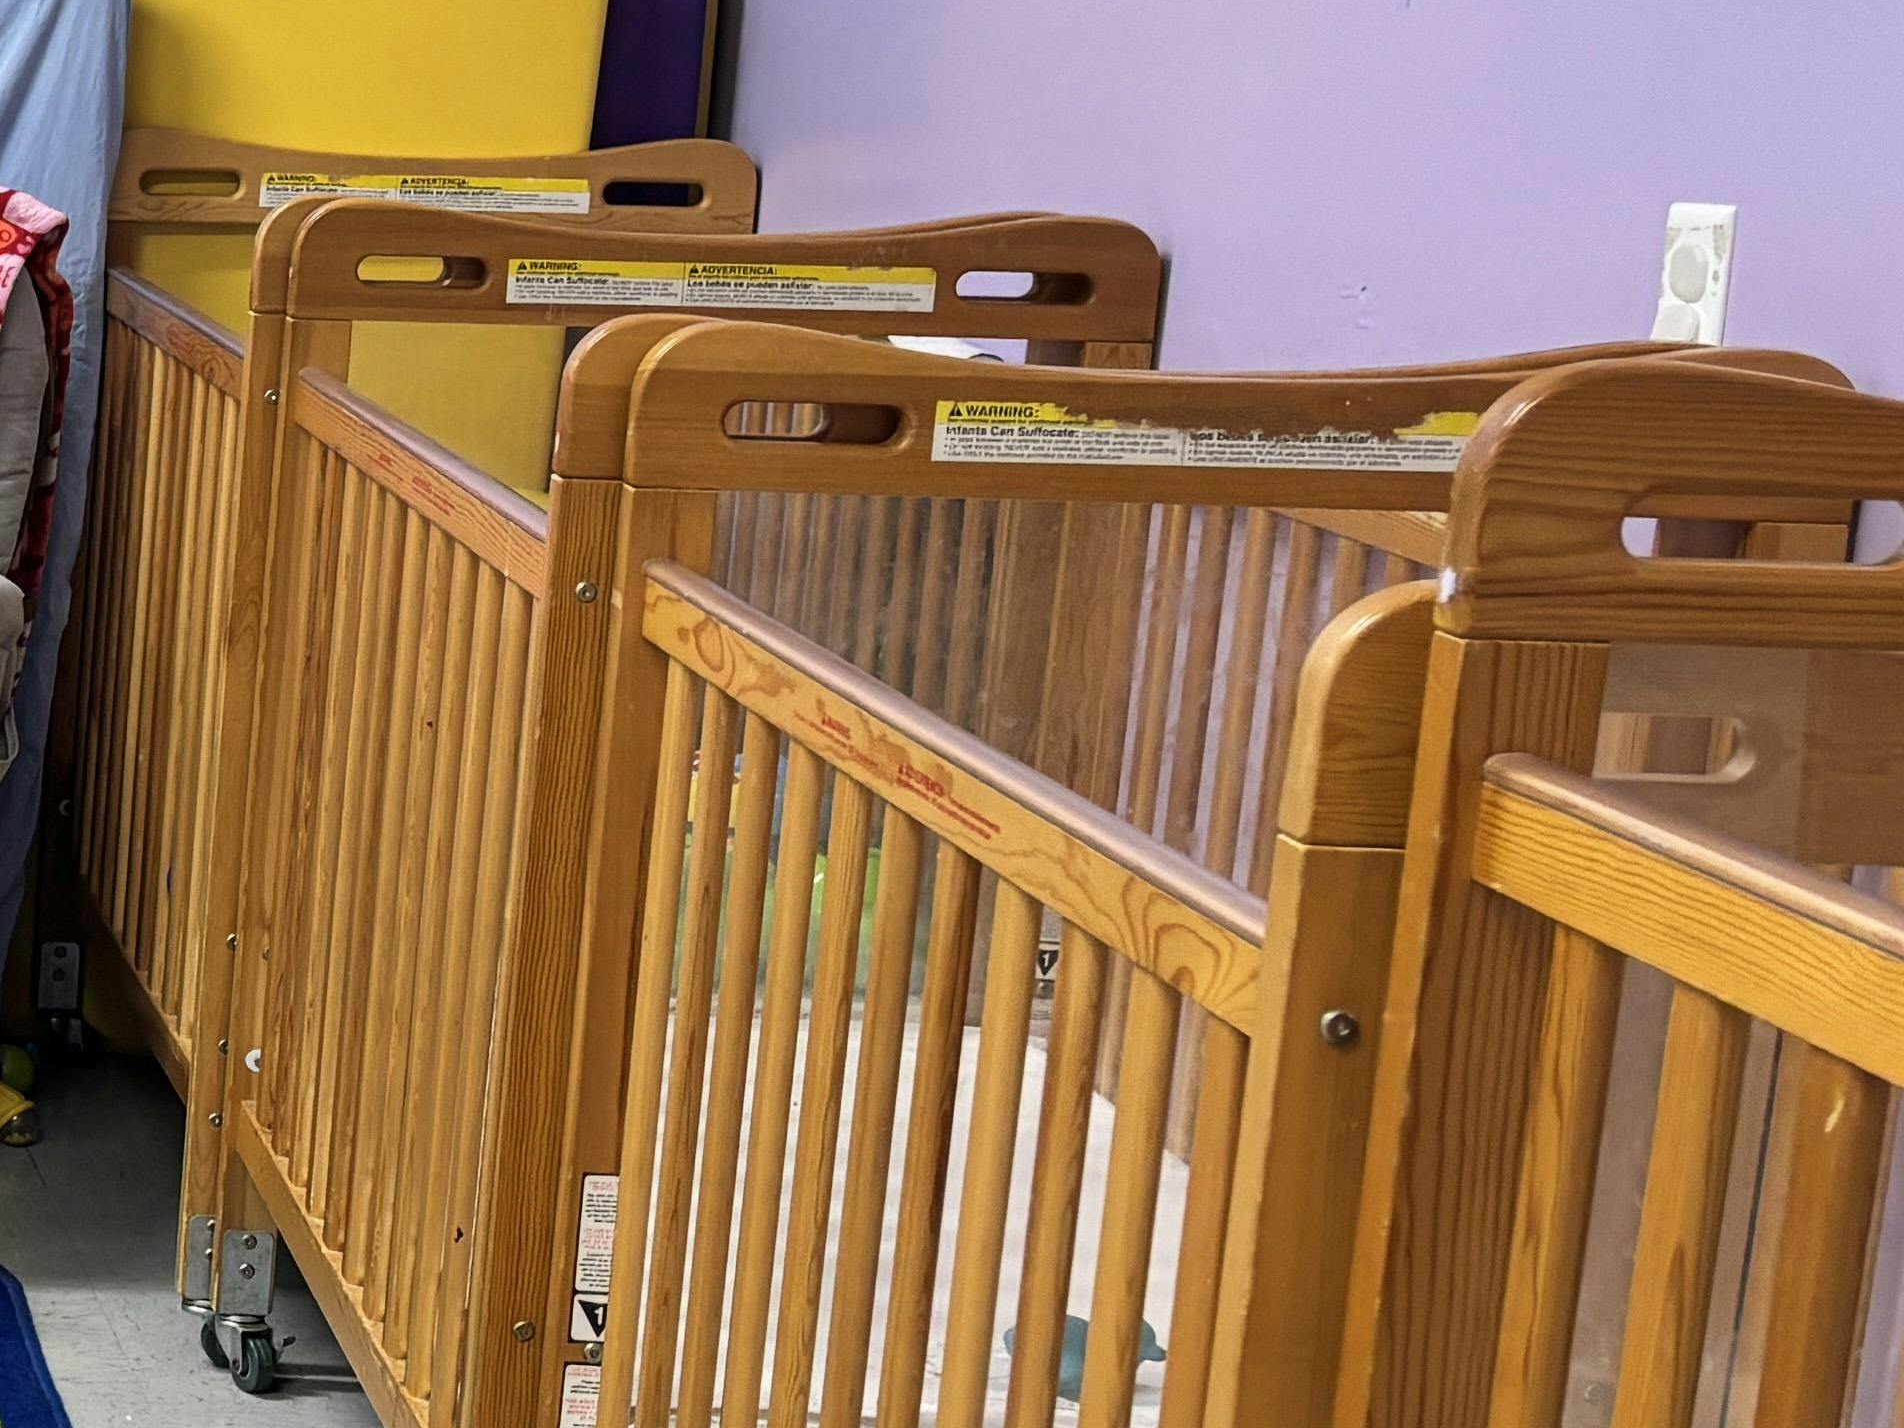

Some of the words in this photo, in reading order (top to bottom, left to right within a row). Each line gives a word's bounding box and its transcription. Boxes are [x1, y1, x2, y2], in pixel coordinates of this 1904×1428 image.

[529, 262, 582, 271] WARNING:
[701, 265, 778, 276] ADVERTENCIA:
[966, 405, 1040, 418] WARNING:
[946, 425, 988, 436] Infants
[990, 425, 1014, 436] Can
